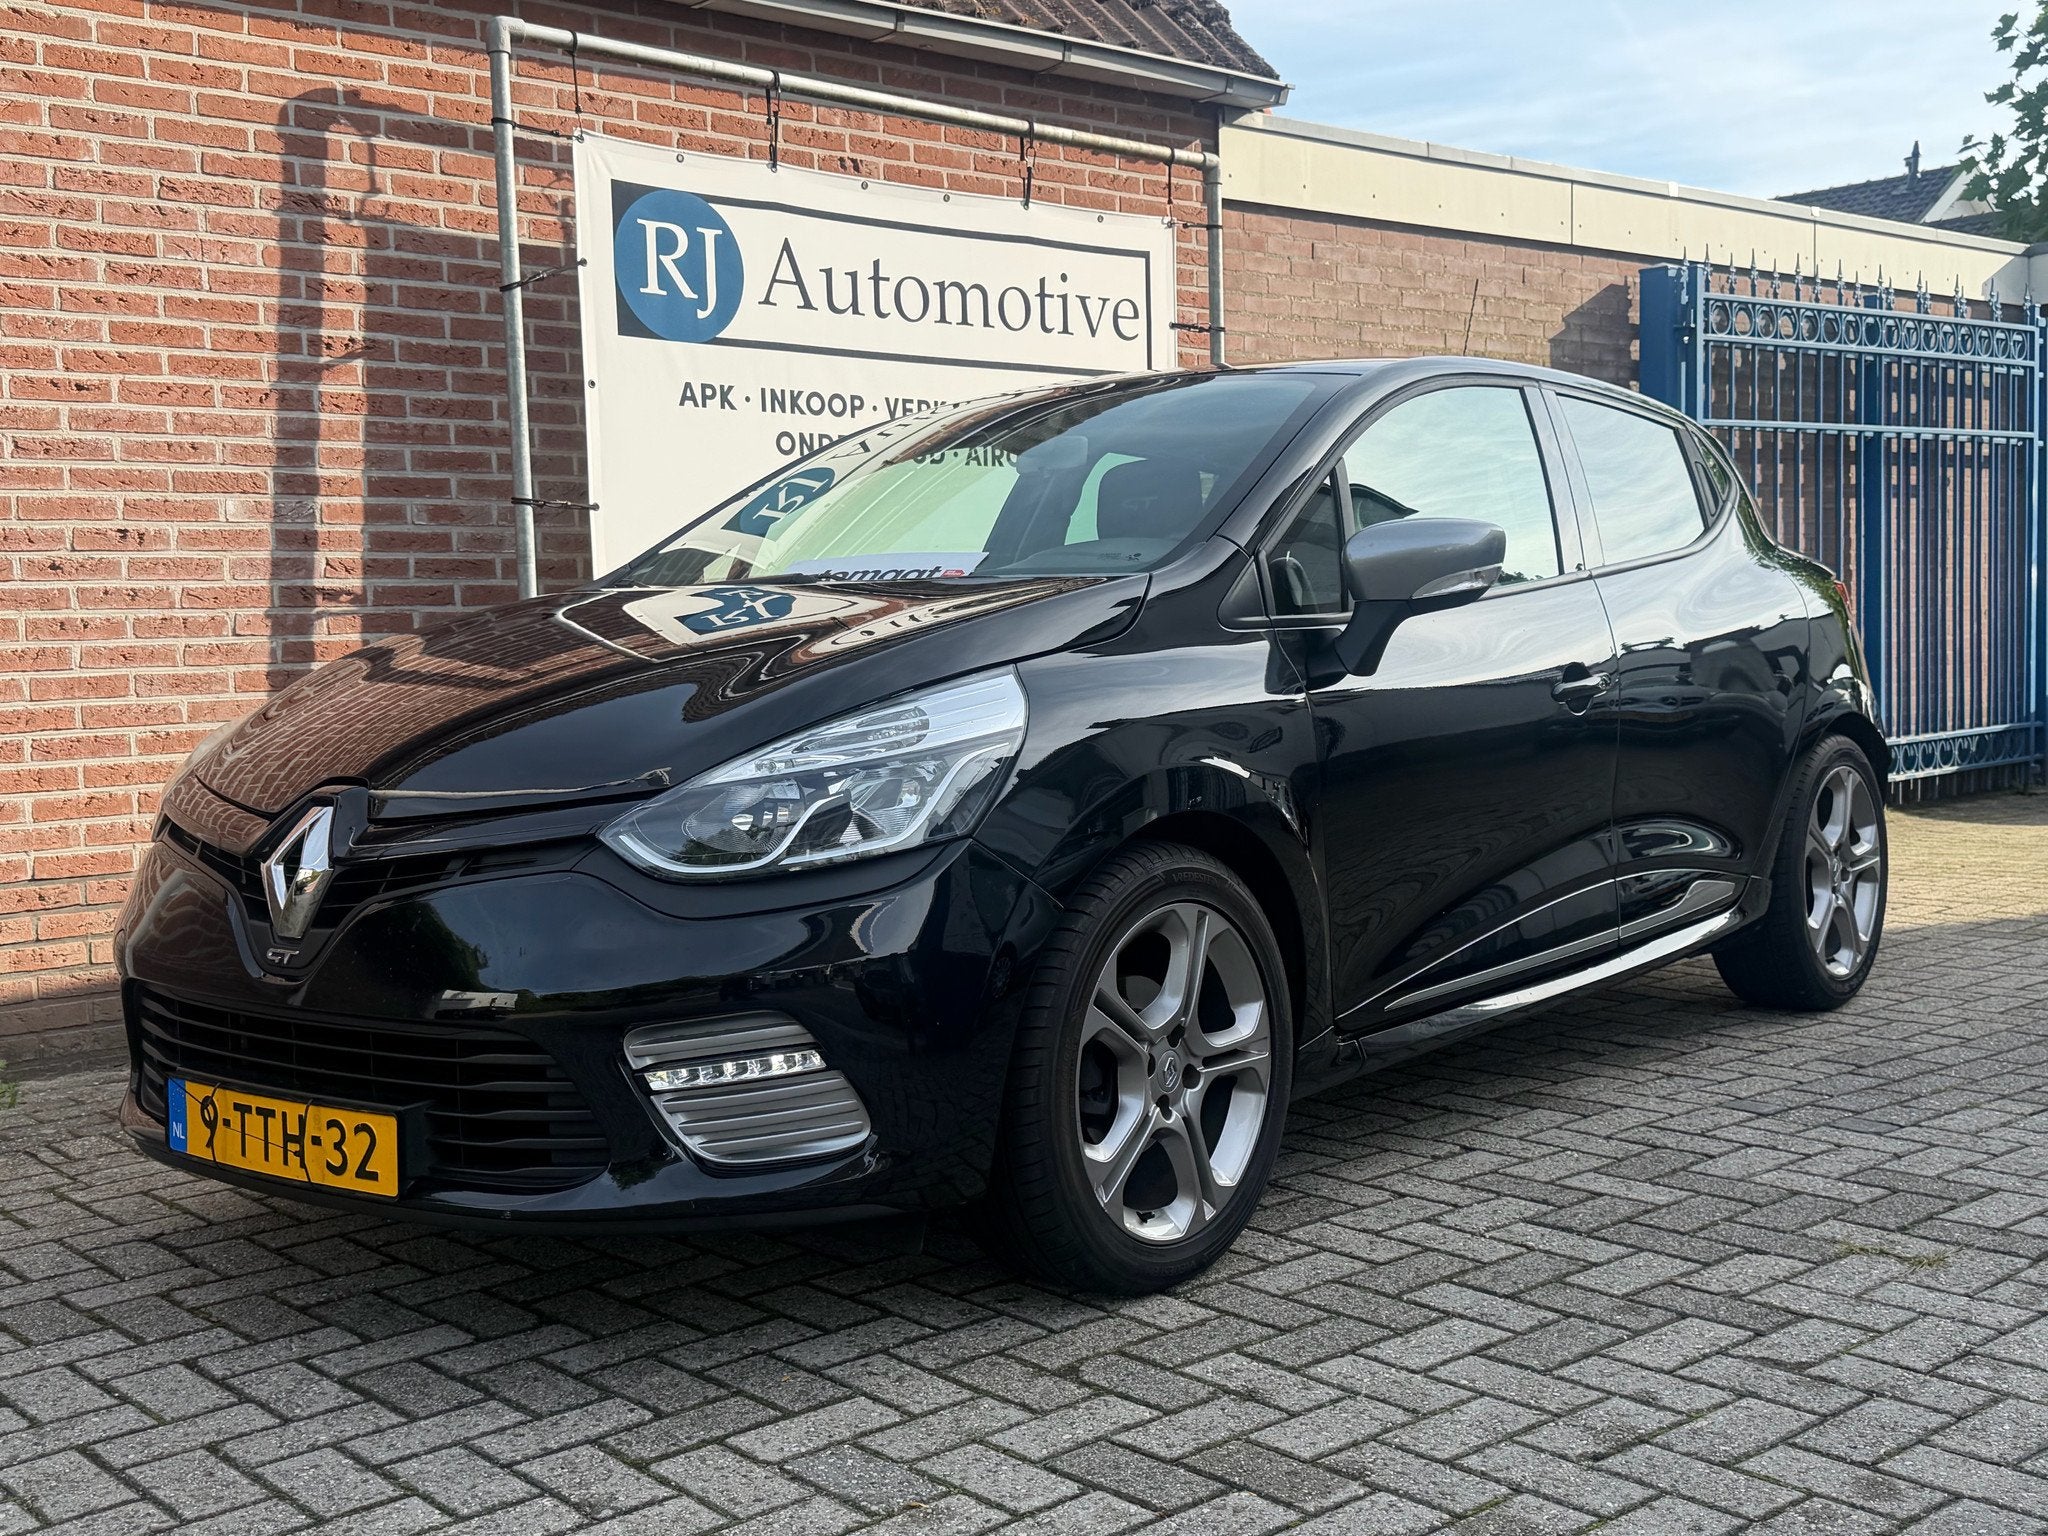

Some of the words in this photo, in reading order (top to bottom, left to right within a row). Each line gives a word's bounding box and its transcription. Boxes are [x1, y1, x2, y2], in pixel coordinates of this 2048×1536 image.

[636, 218, 723, 320] RJ
[758, 237, 1140, 342] Automotive
[678, 381, 737, 411] APK
[760, 387, 865, 419] INKOOP
[267, 948, 300, 965] GT
[172, 1121, 185, 1139] NL
[200, 1095, 379, 1182] 9-TTH-32
